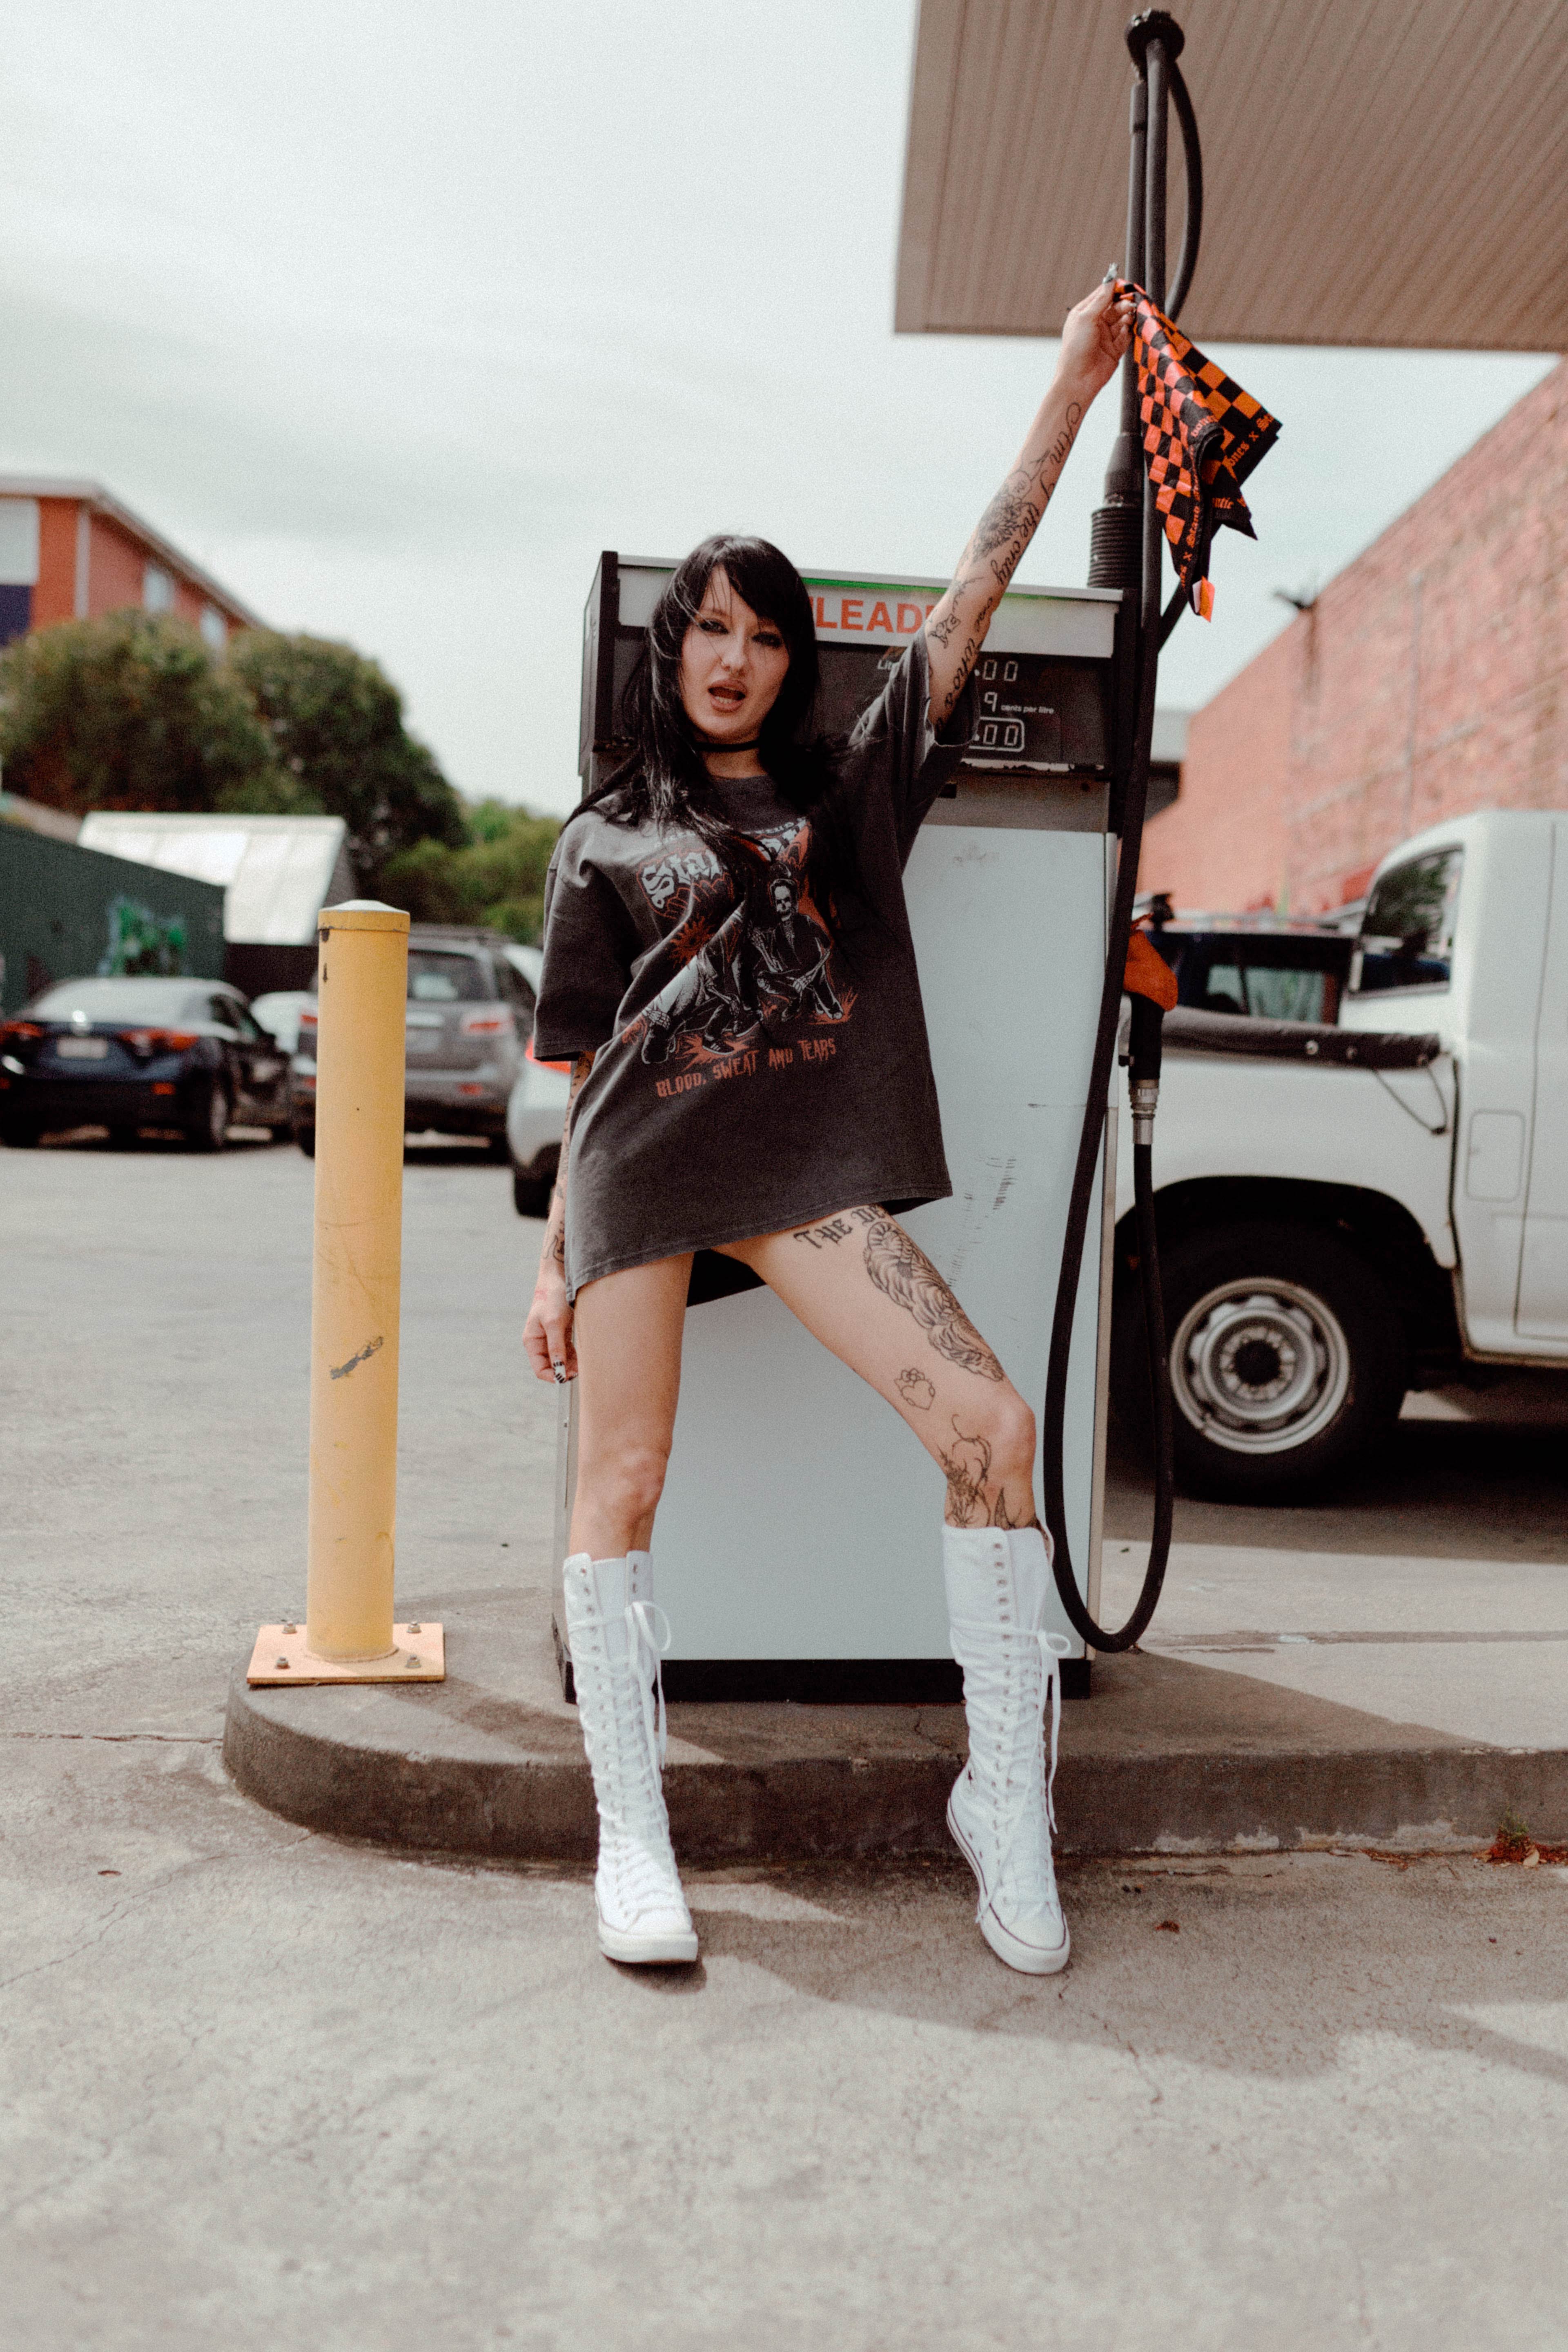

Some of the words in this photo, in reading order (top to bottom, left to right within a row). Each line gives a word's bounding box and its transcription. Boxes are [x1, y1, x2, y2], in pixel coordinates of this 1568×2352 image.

[808, 596, 934, 635] LEAD
[656, 1073, 707, 1098] BLOOD,
[712, 1050, 760, 1080] SWEAT
[768, 1048, 793, 1071] AND
[793, 1218, 853, 1249] THE
